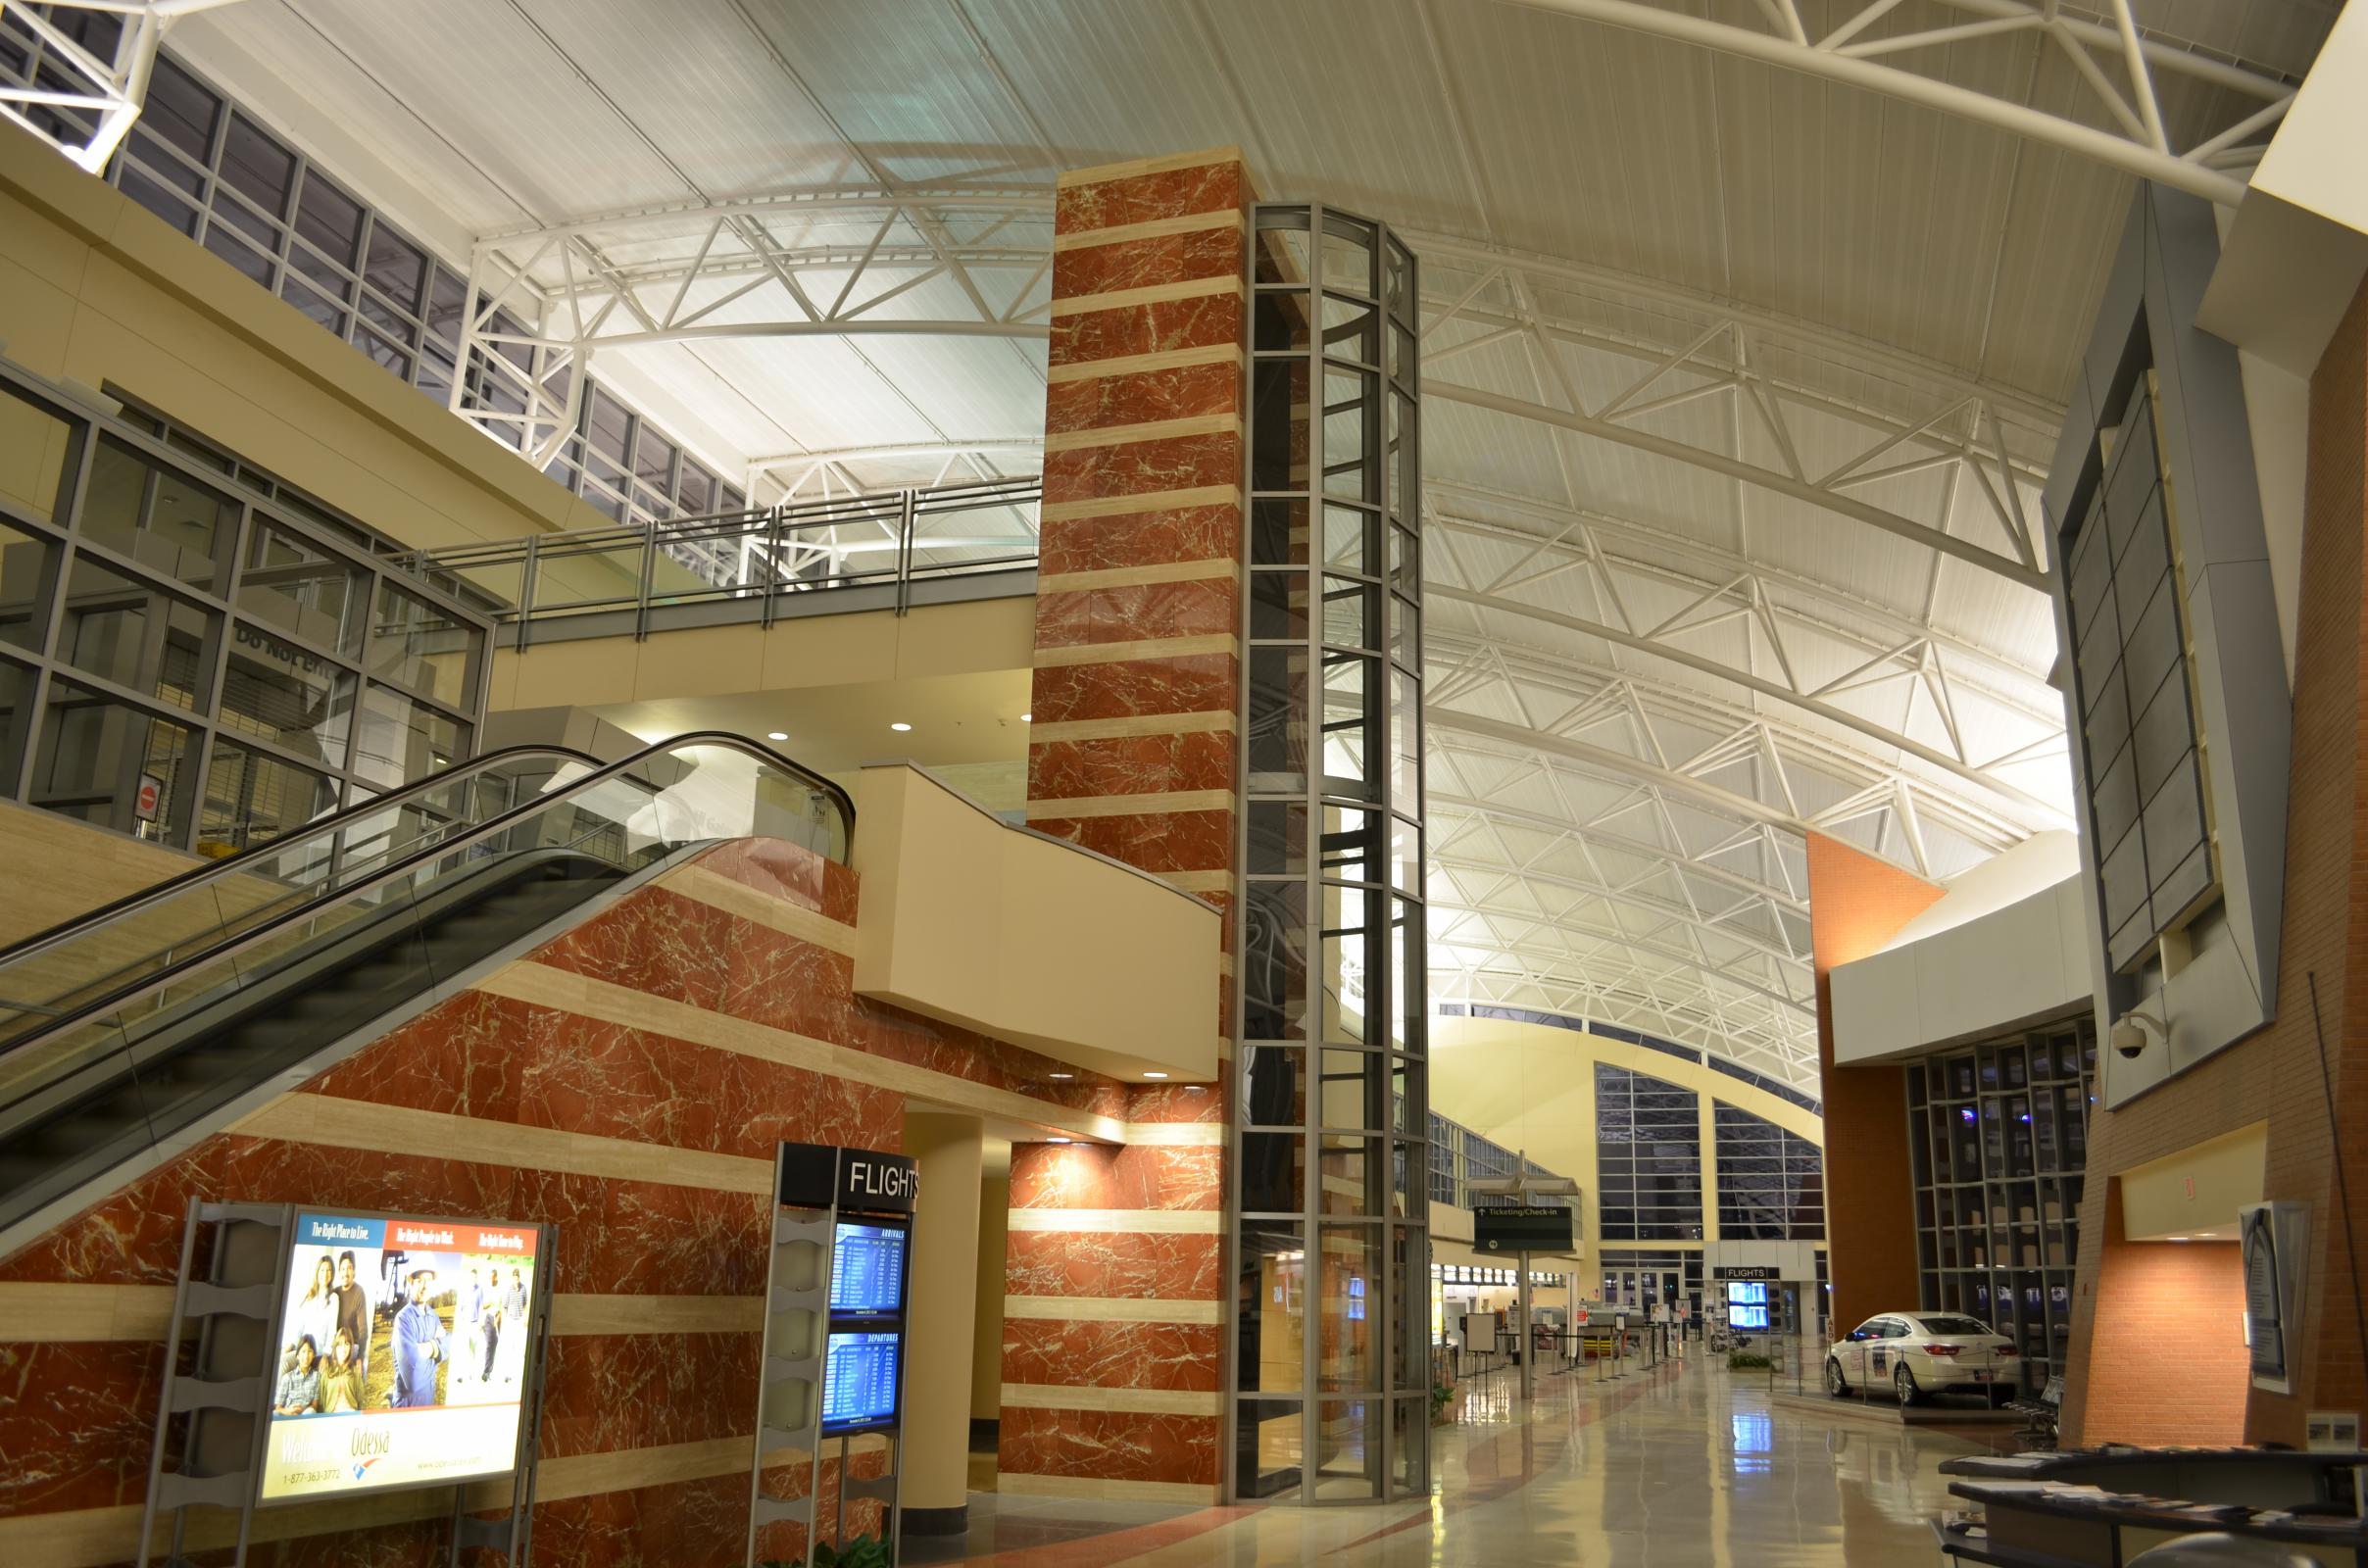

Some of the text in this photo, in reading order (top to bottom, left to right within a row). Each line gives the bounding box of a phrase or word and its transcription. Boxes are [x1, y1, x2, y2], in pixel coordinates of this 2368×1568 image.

[850, 1161, 920, 1200] FLIGHTS
[1489, 1207, 1557, 1217] Ticketing/Check-in
[312, 1222, 321, 1237] The
[322, 1223, 337, 1240] Right
[337, 1223, 350, 1239] Place
[881, 1228, 905, 1239] ARRIVALS
[866, 1333, 899, 1343] DEPARTURES
[351, 1427, 390, 1457] Odessa
[283, 1469, 341, 1484] 1-877-363-3772
